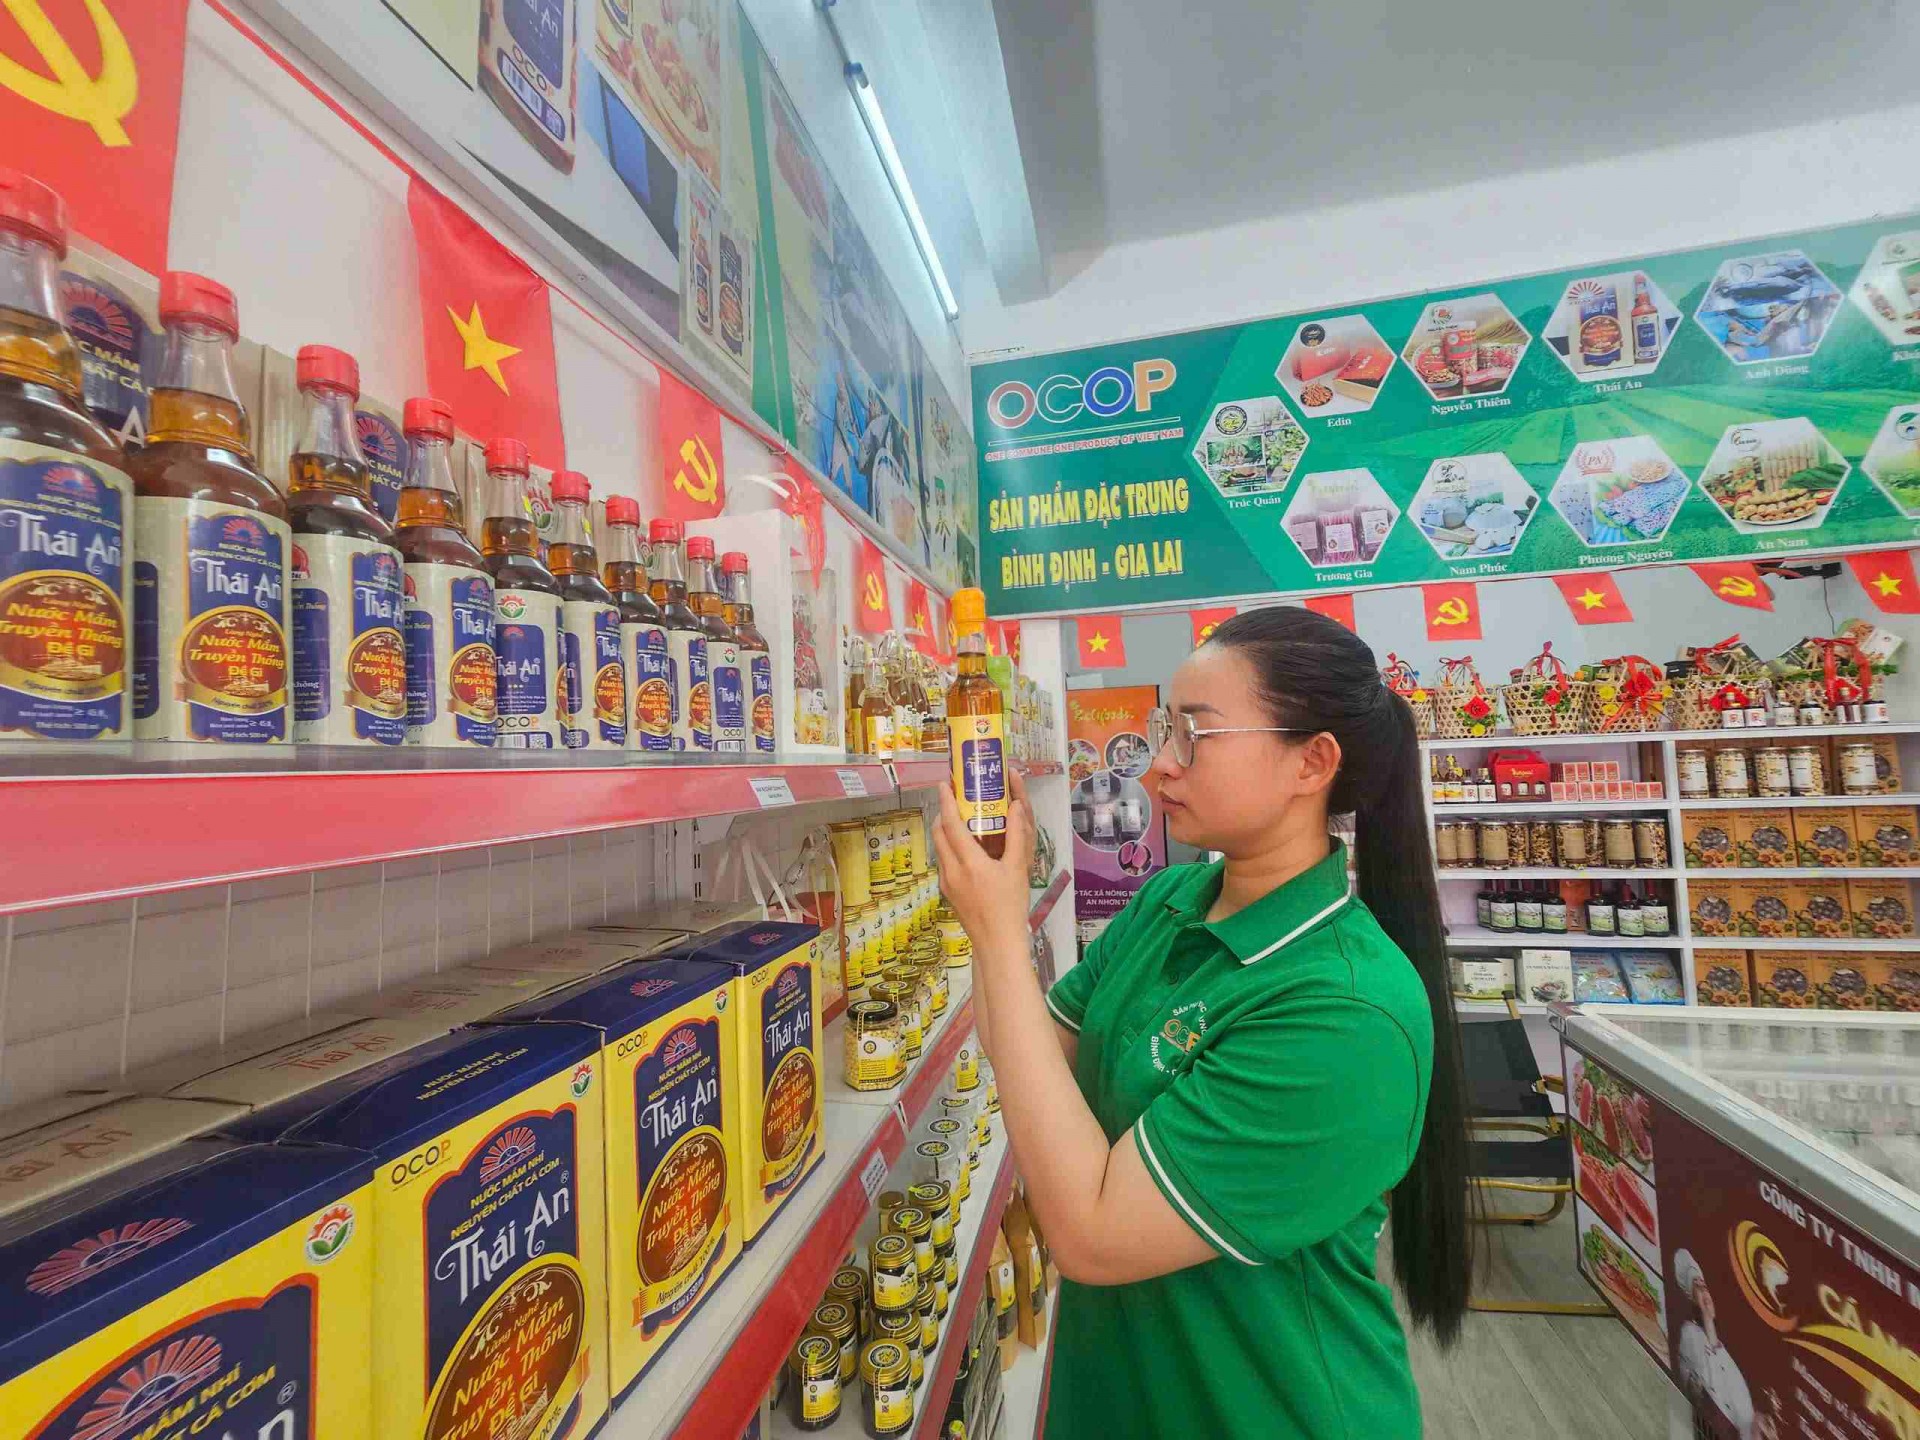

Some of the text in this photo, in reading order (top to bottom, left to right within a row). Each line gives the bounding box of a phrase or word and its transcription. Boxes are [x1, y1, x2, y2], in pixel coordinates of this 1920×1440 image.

[987, 358, 1177, 429] OCOP
[1625, 380, 1642, 390] An
[984, 428, 1184, 462] ONE COMMUNE ONE PRODUCT OF VIET NAM
[989, 490, 1024, 533] SẢN
[1029, 481, 1081, 528] PHẨM
[1084, 481, 1121, 529] ĐẶC
[0, 509, 121, 575] Thái An
[1002, 548, 1045, 590] BÌNH
[1050, 548, 1097, 593] ĐỊNH
[1115, 542, 1151, 579] GIA
[1152, 539, 1184, 575] LAI
[1754, 536, 1809, 551] An Nam
[189, 557, 282, 608] Thái An
[1354, 569, 1373, 579] Gia
[1450, 561, 1508, 576] Nam Phúc
[200, 634, 244, 648] Nước
[518, 658, 541, 684] An
[617, 1030, 648, 1057] OCOP
[764, 1009, 810, 1059] Thái An
[640, 1078, 717, 1148] Thái An
[391, 1139, 451, 1185] OCOP
[470, 1164, 527, 1210] NƯỚC MẮM
[450, 1157, 560, 1241] NGUYÊN CHẤT CÁ CƠM
[645, 1171, 721, 1252] Truyền Thống
[652, 1157, 716, 1225] Nước Mắm
[435, 1187, 571, 1305] Thái An
[1759, 1180, 1807, 1230] CÔNG
[1807, 1212, 1835, 1248] TY
[1837, 1233, 1903, 1297] TNHH
[451, 1297, 565, 1417] Nước Mắm
[519, 1312, 574, 1377] Thống
